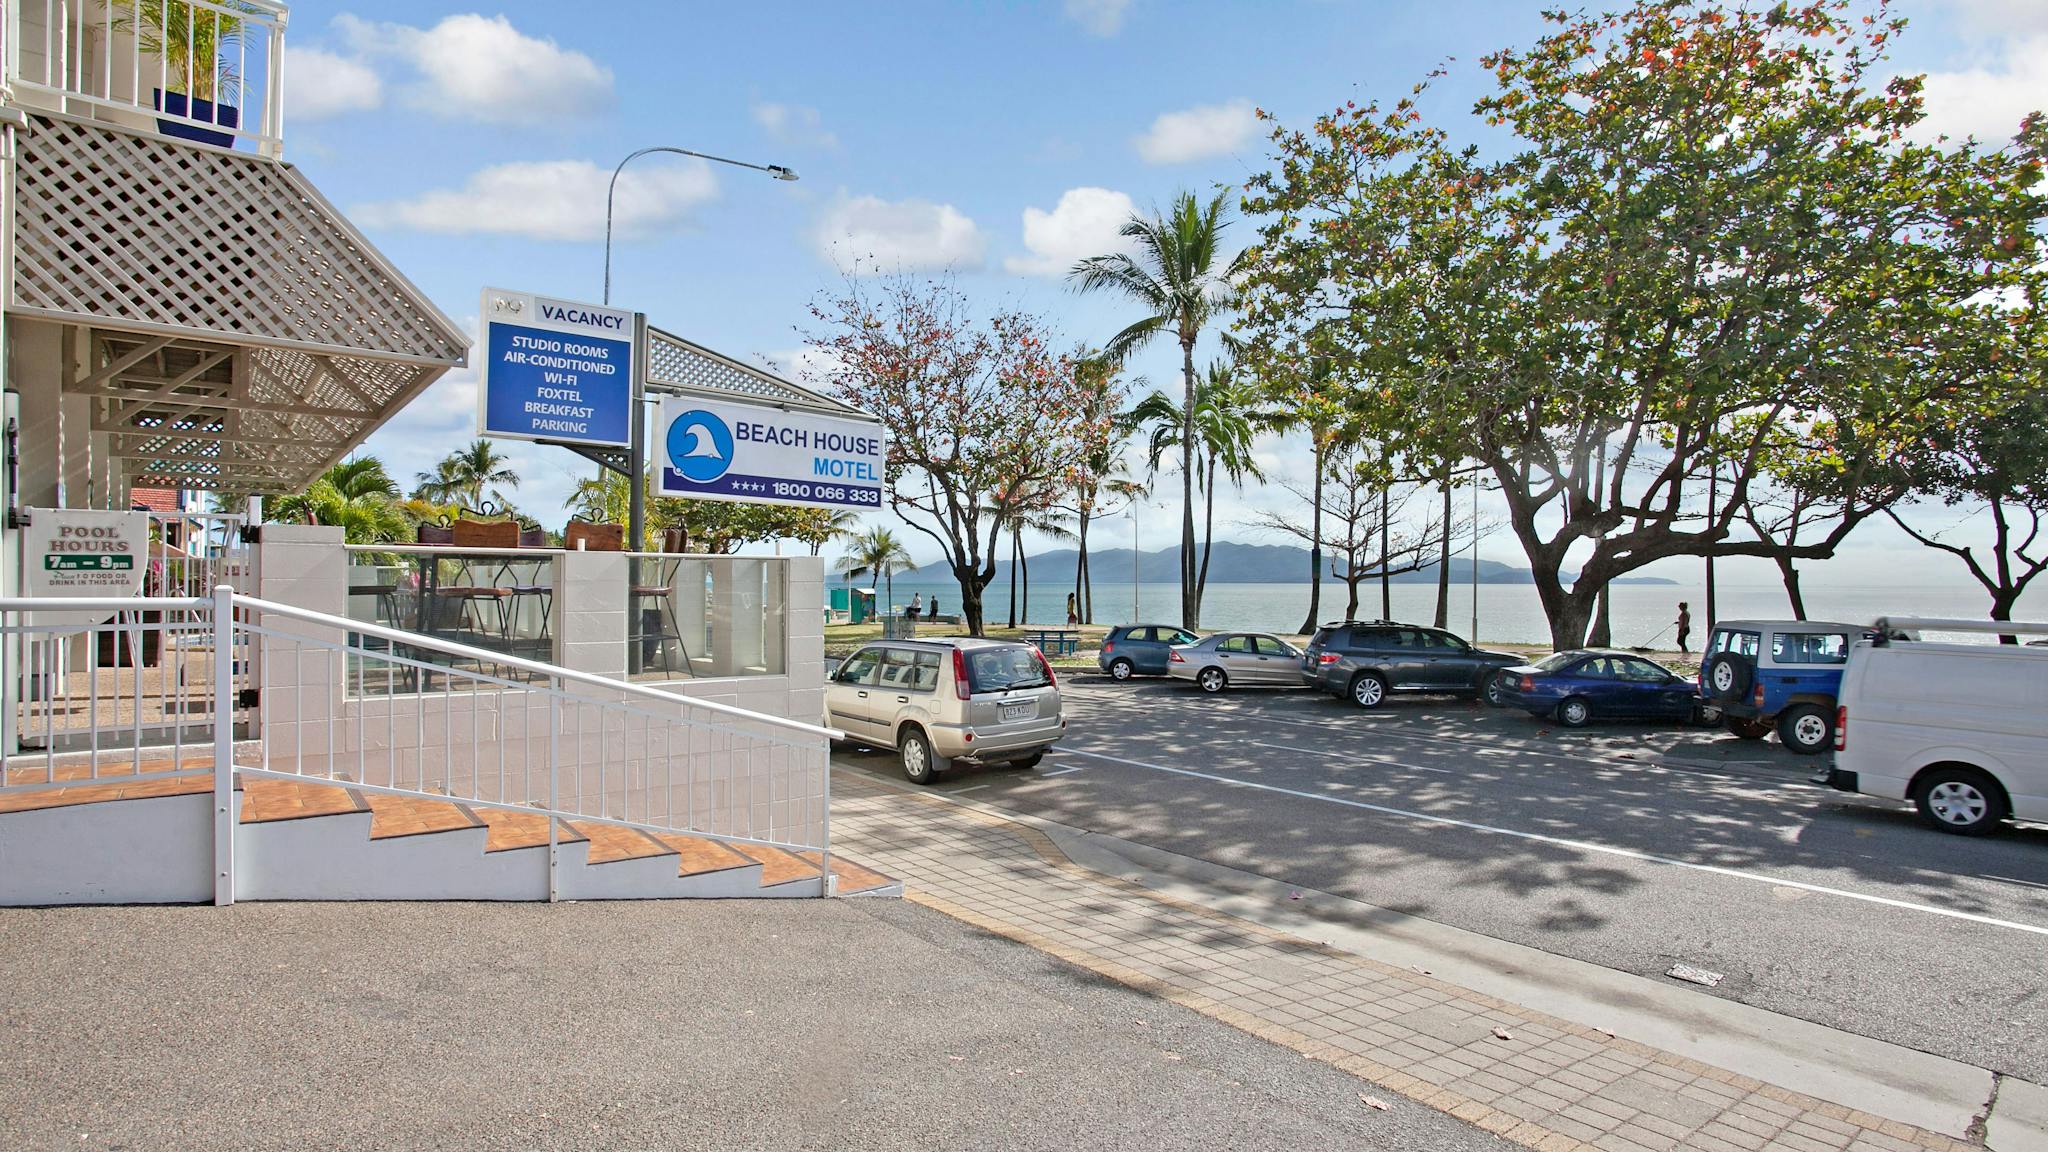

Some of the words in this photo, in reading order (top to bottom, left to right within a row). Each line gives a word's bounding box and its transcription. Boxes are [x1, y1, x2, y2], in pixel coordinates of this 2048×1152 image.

[542, 304, 624, 330] VACANCY
[512, 335, 561, 353] STUDIO
[564, 342, 609, 359] ROOMS
[504, 350, 616, 375] AIR-CONDITIONED
[544, 371, 578, 386] WI-FI
[537, 386, 583, 402] FOXTEL
[525, 401, 595, 419] BREAKFAST
[532, 418, 587, 434] PARKING
[736, 421, 808, 449] BEACH
[814, 431, 879, 456] HOUSE
[813, 457, 878, 481] MOTEL
[772, 481, 811, 497] 1800
[814, 485, 845, 501] 066
[849, 488, 878, 503] 333
[60, 526, 120, 538] POOL
[50, 540, 129, 552] HOURS
[48, 555, 77, 569] 7am
[100, 555, 129, 570] 9pm
